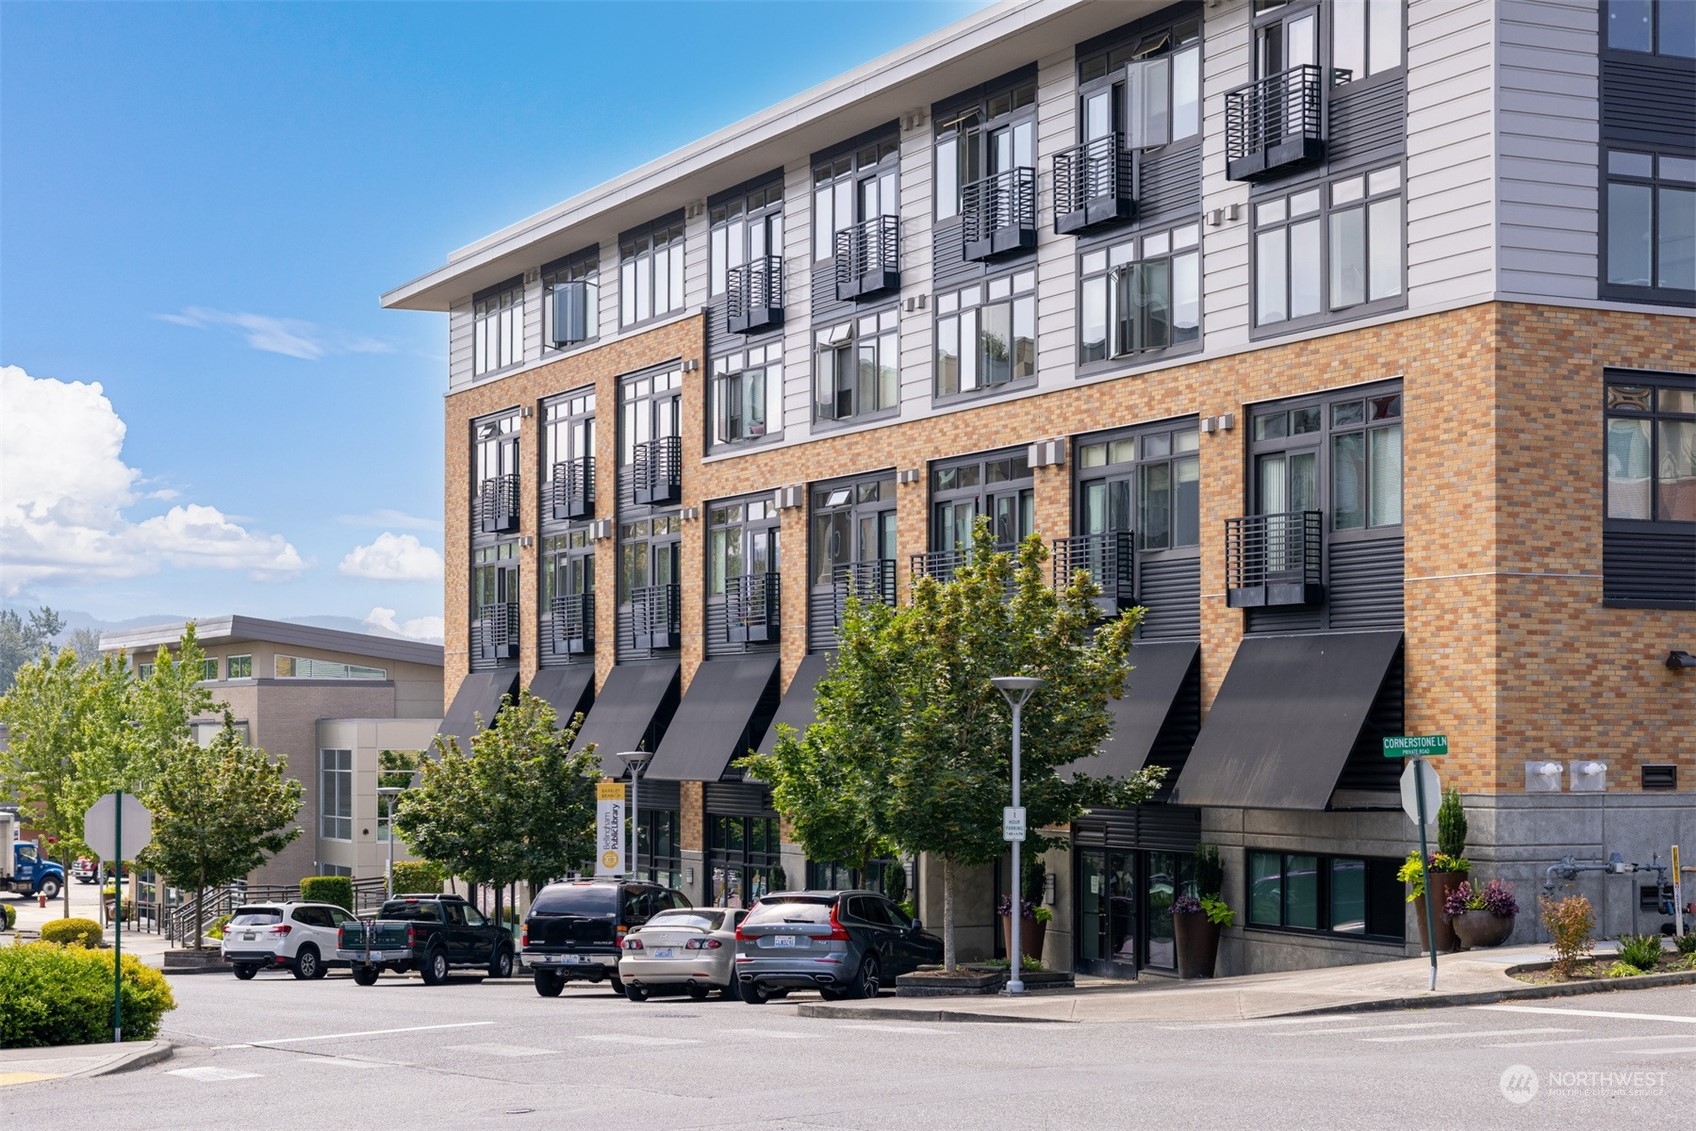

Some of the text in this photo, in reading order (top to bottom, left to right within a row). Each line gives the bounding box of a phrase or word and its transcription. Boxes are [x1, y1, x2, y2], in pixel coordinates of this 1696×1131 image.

[1384, 736, 1447, 748] CORNERSTONE LN
[611, 803, 621, 829] Library
[603, 812, 611, 850] Bellingham
